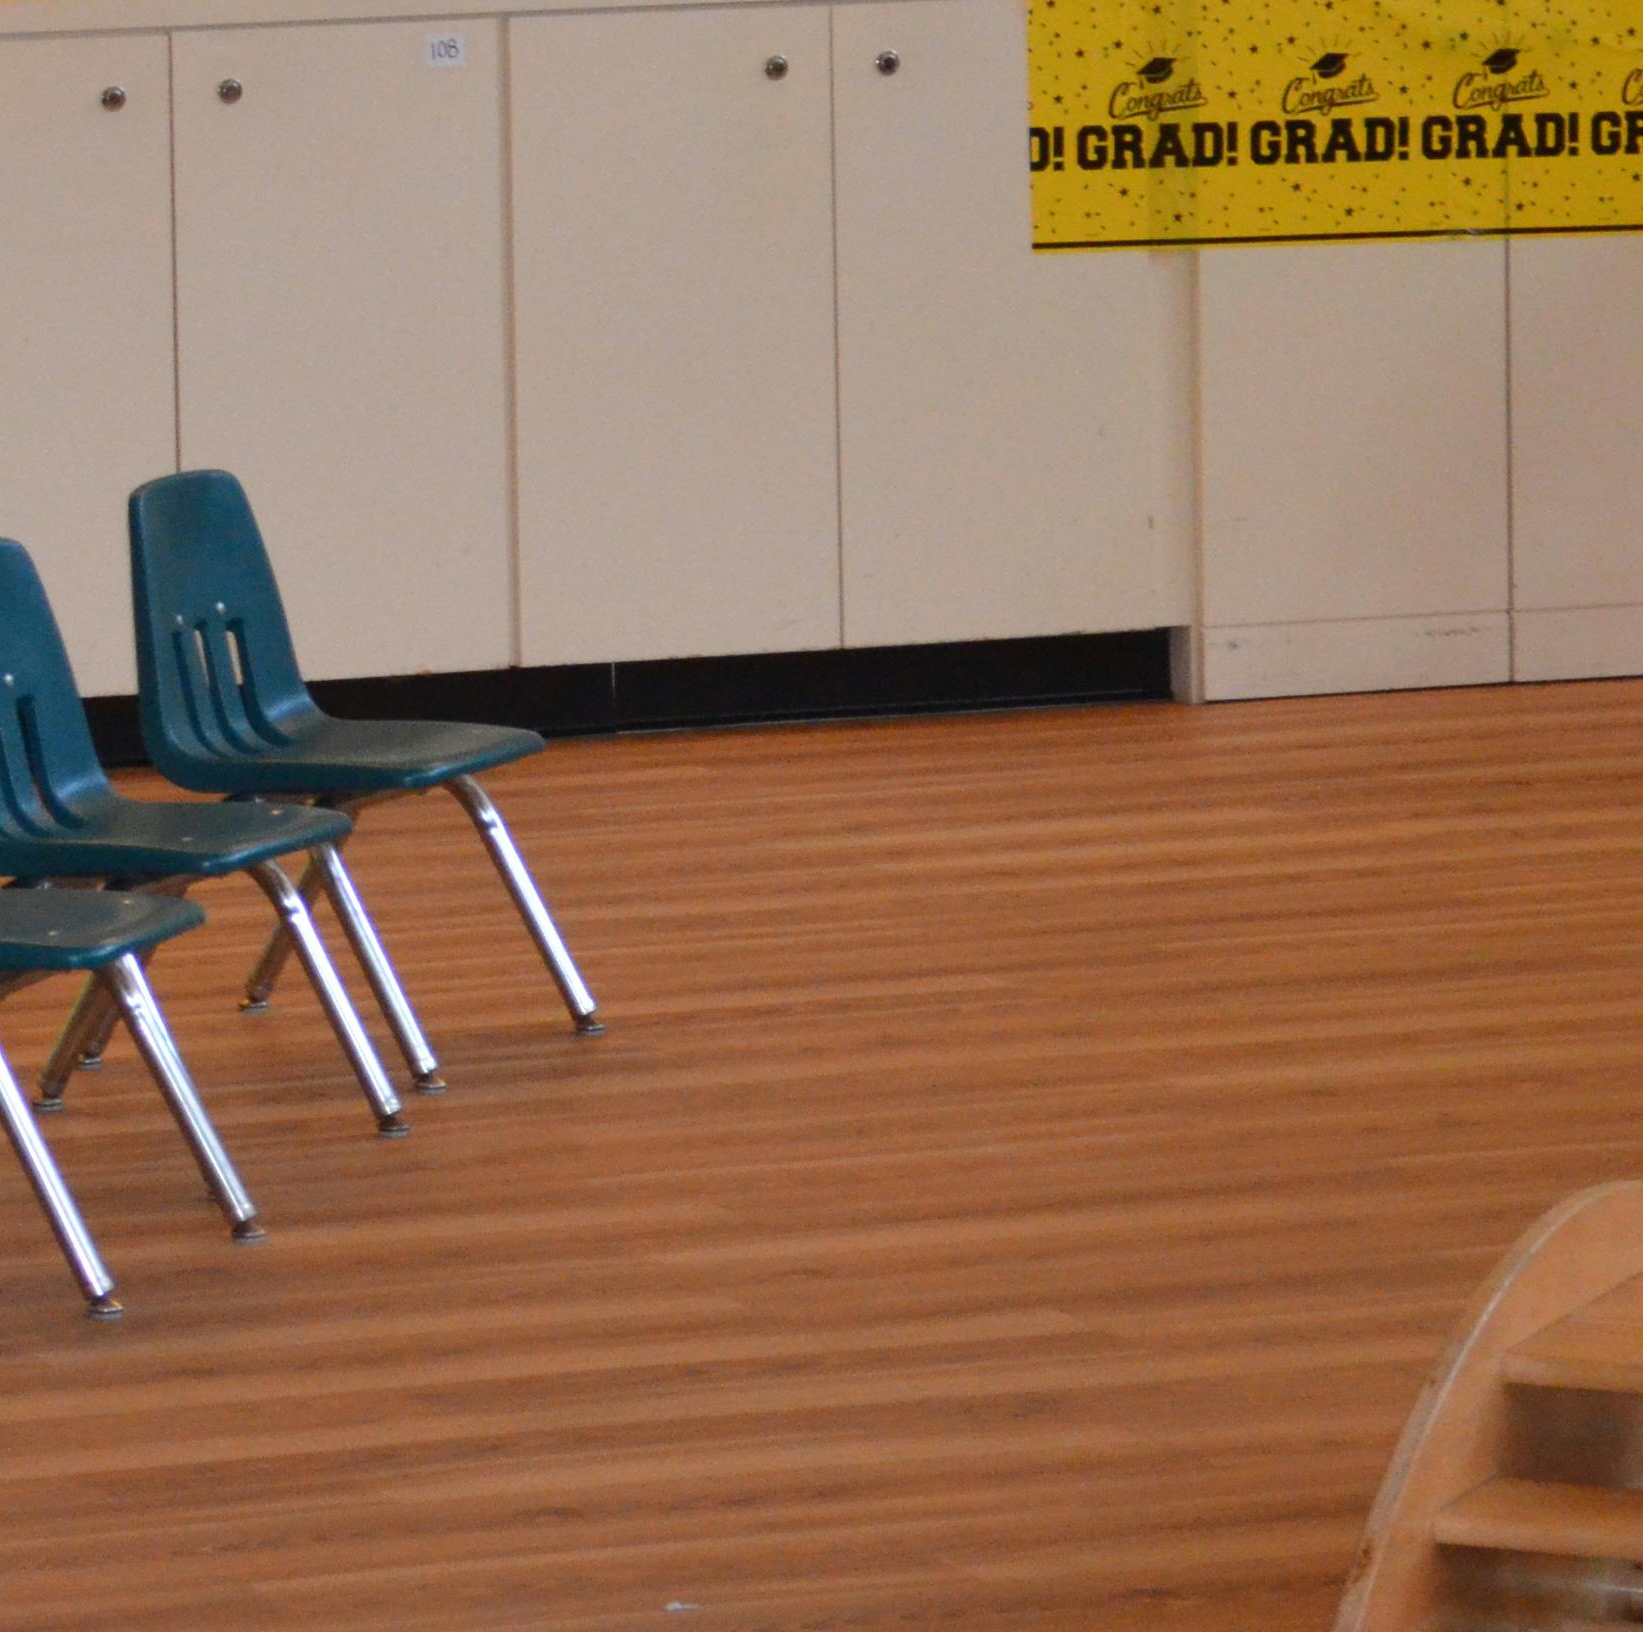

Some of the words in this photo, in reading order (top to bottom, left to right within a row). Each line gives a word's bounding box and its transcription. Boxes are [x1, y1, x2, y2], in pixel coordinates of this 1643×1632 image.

[431, 38, 460, 60] 108
[1109, 78, 1208, 121] Congrats
[1282, 73, 1380, 116] Congrats
[1452, 69, 1551, 112] Congrats
[1077, 121, 1238, 171] GRAD!
[1250, 116, 1410, 165] GRAD!
[1421, 112, 1579, 160] GRAD!
